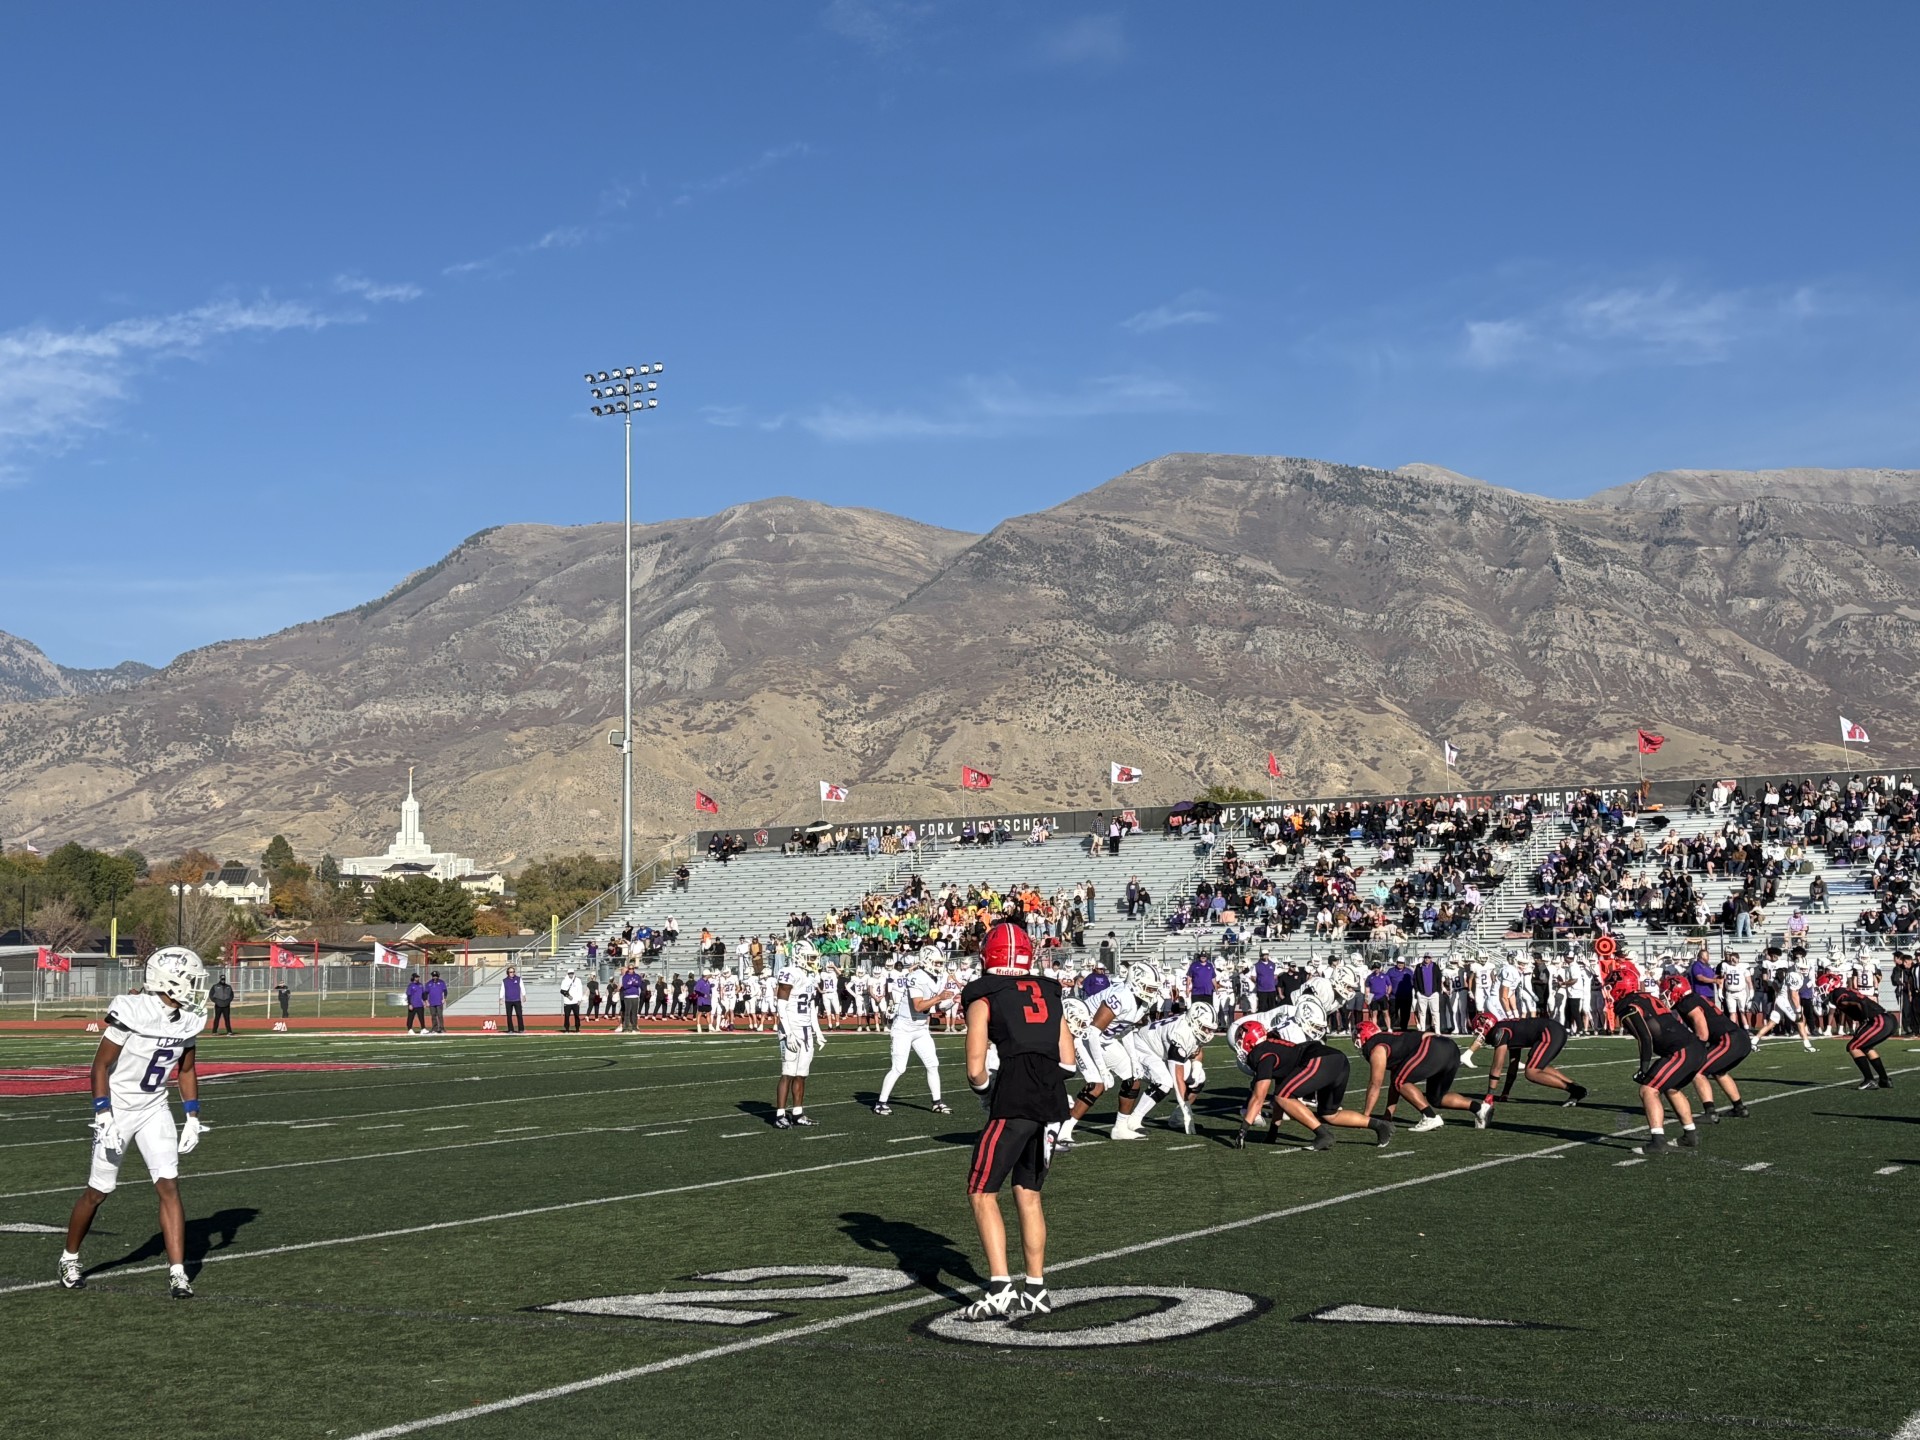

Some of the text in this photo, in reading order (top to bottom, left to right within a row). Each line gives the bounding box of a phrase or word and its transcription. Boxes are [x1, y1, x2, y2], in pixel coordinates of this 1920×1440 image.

[920, 822, 954, 837] FORK
[778, 971, 791, 983] 24
[1480, 973, 1488, 986] 2
[1726, 973, 1740, 986] 95
[1861, 973, 1869, 987] 8
[824, 979, 835, 990] 64
[1016, 980, 1049, 1024] 3
[1107, 994, 1122, 1010] 55
[139, 1048, 174, 1093] 6
